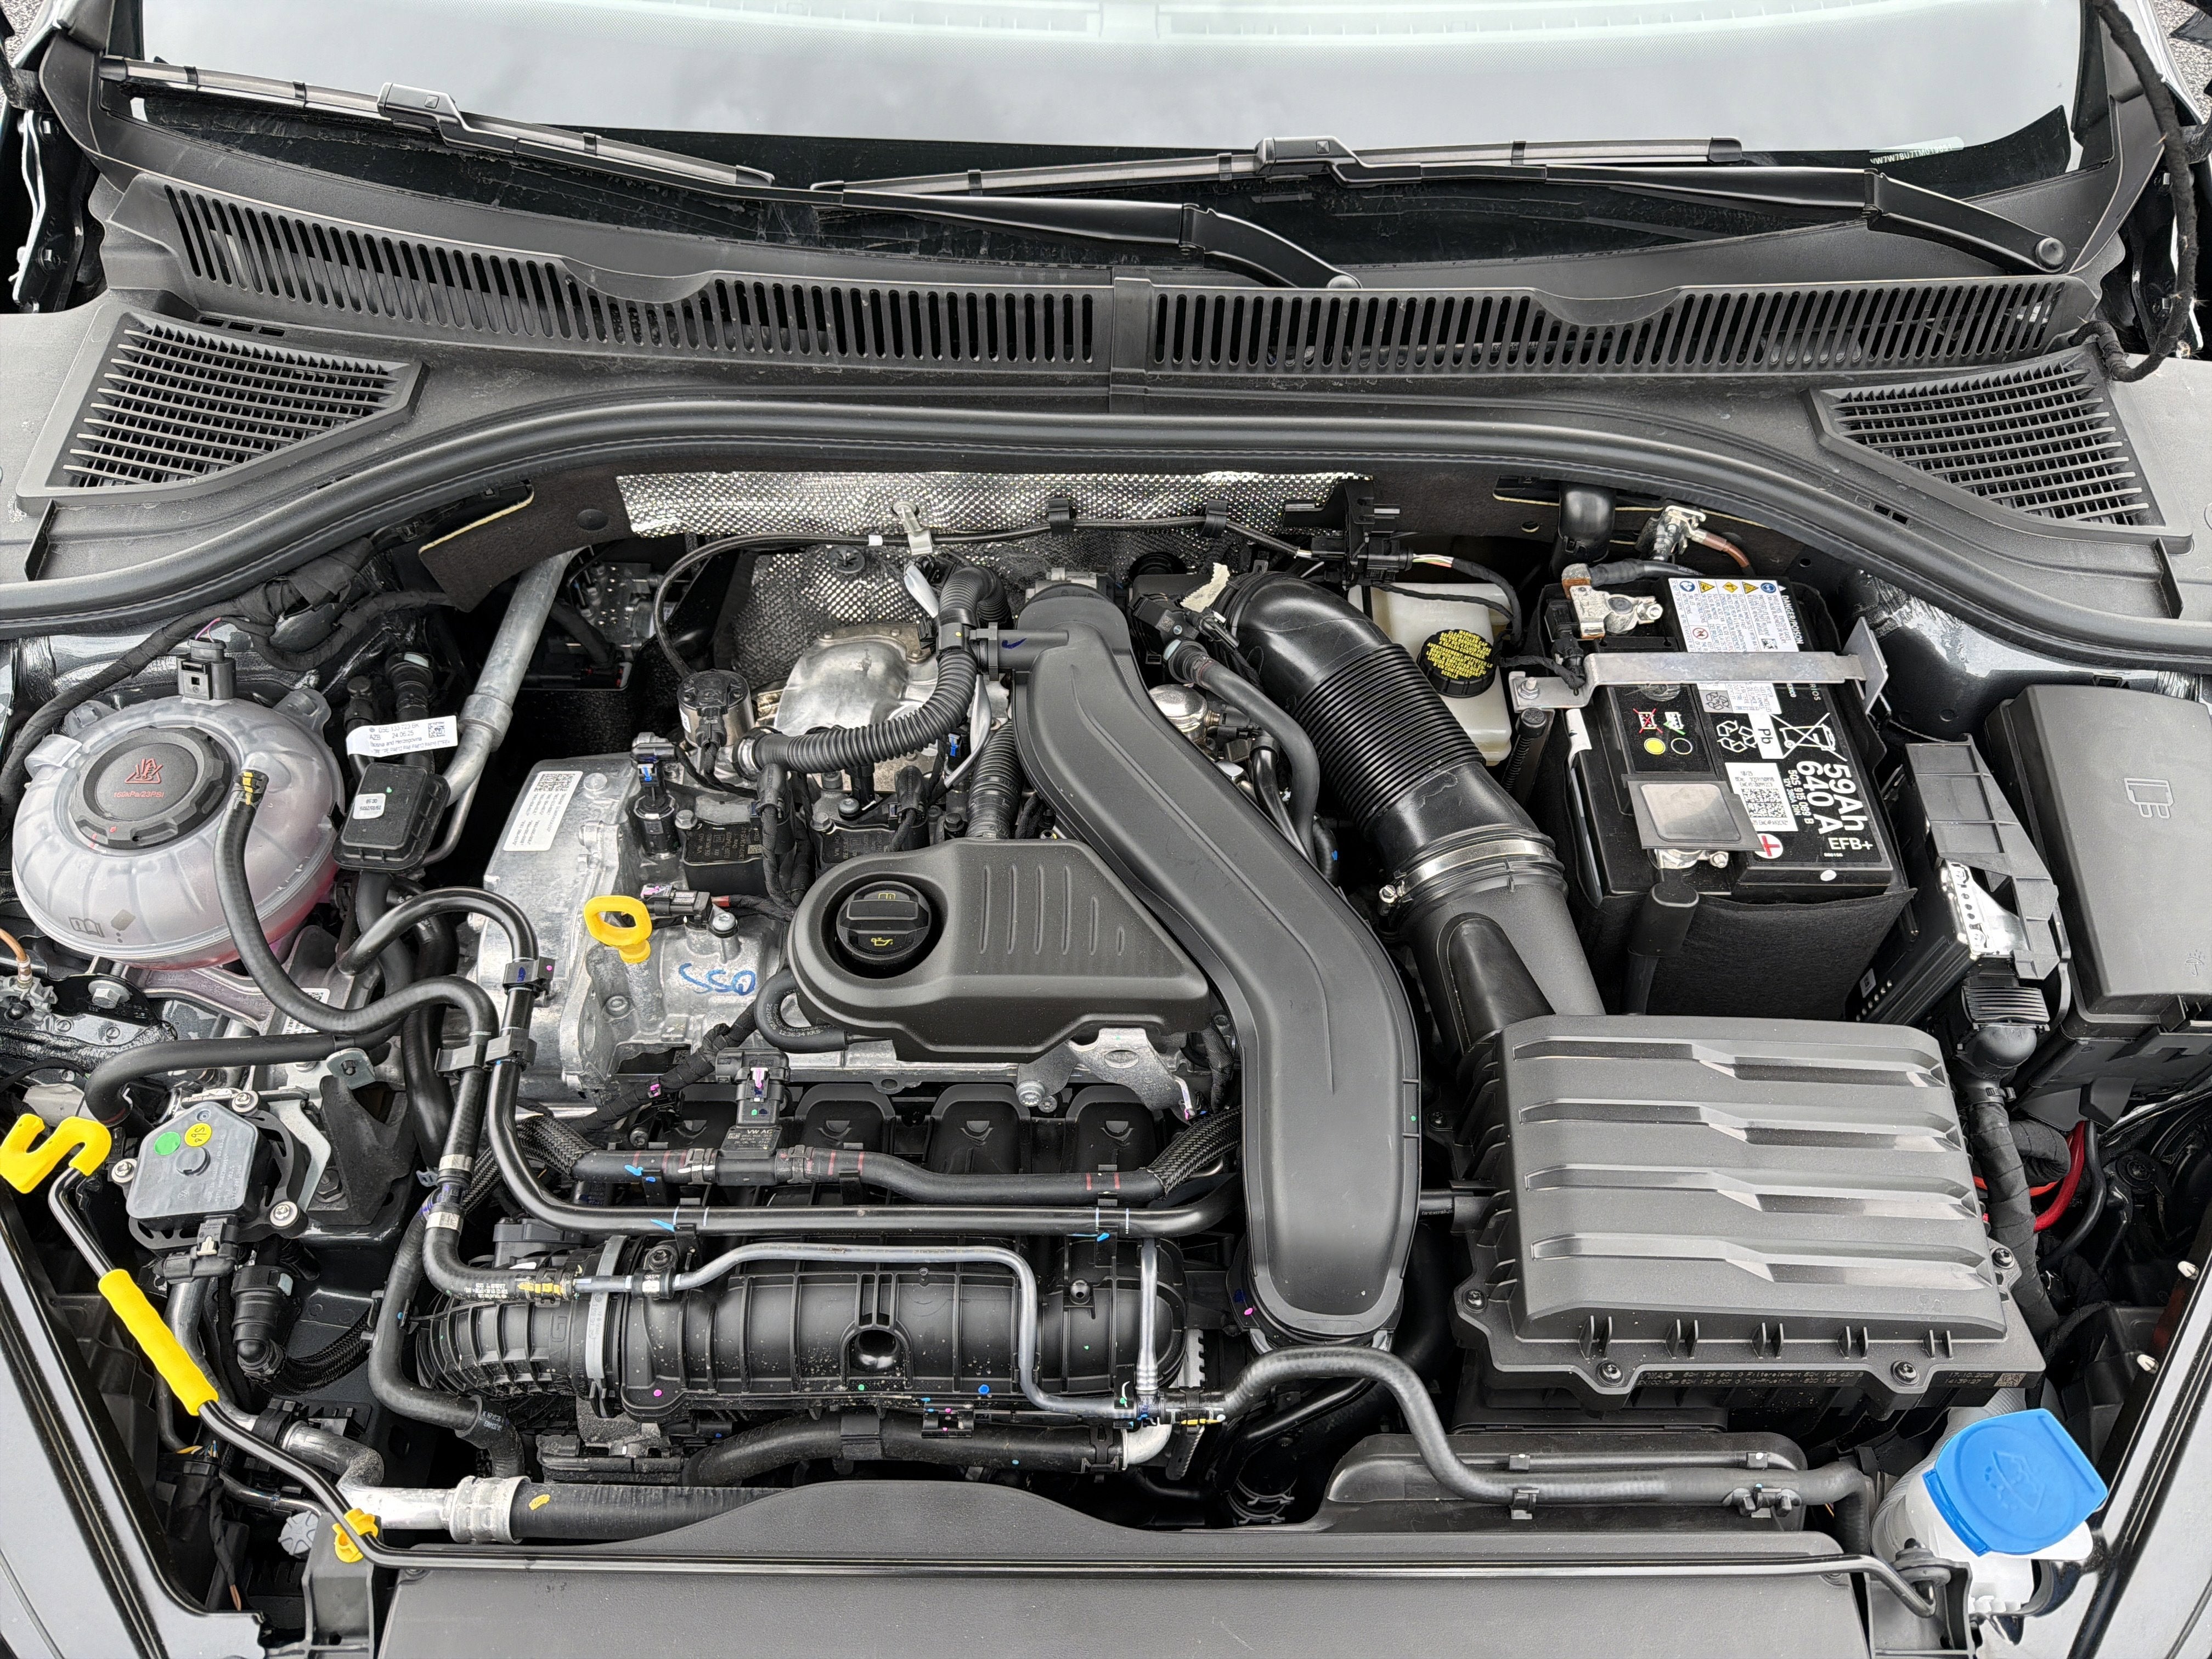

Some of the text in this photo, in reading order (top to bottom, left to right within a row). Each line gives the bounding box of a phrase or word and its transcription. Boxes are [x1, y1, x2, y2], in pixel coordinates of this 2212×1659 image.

[1781, 595, 1803, 644] DANGER/POISON
[1757, 728, 1772, 744] Pb
[1793, 787, 1805, 799] 915
[1796, 761, 1835, 806] 640
[1783, 777, 1801, 815] 12V 380A DIN
[1822, 763, 1869, 831] 59Ah
[1798, 802, 1812, 816] 089
[1813, 814, 1843, 834] A
[1827, 837, 1873, 850] EFB+
